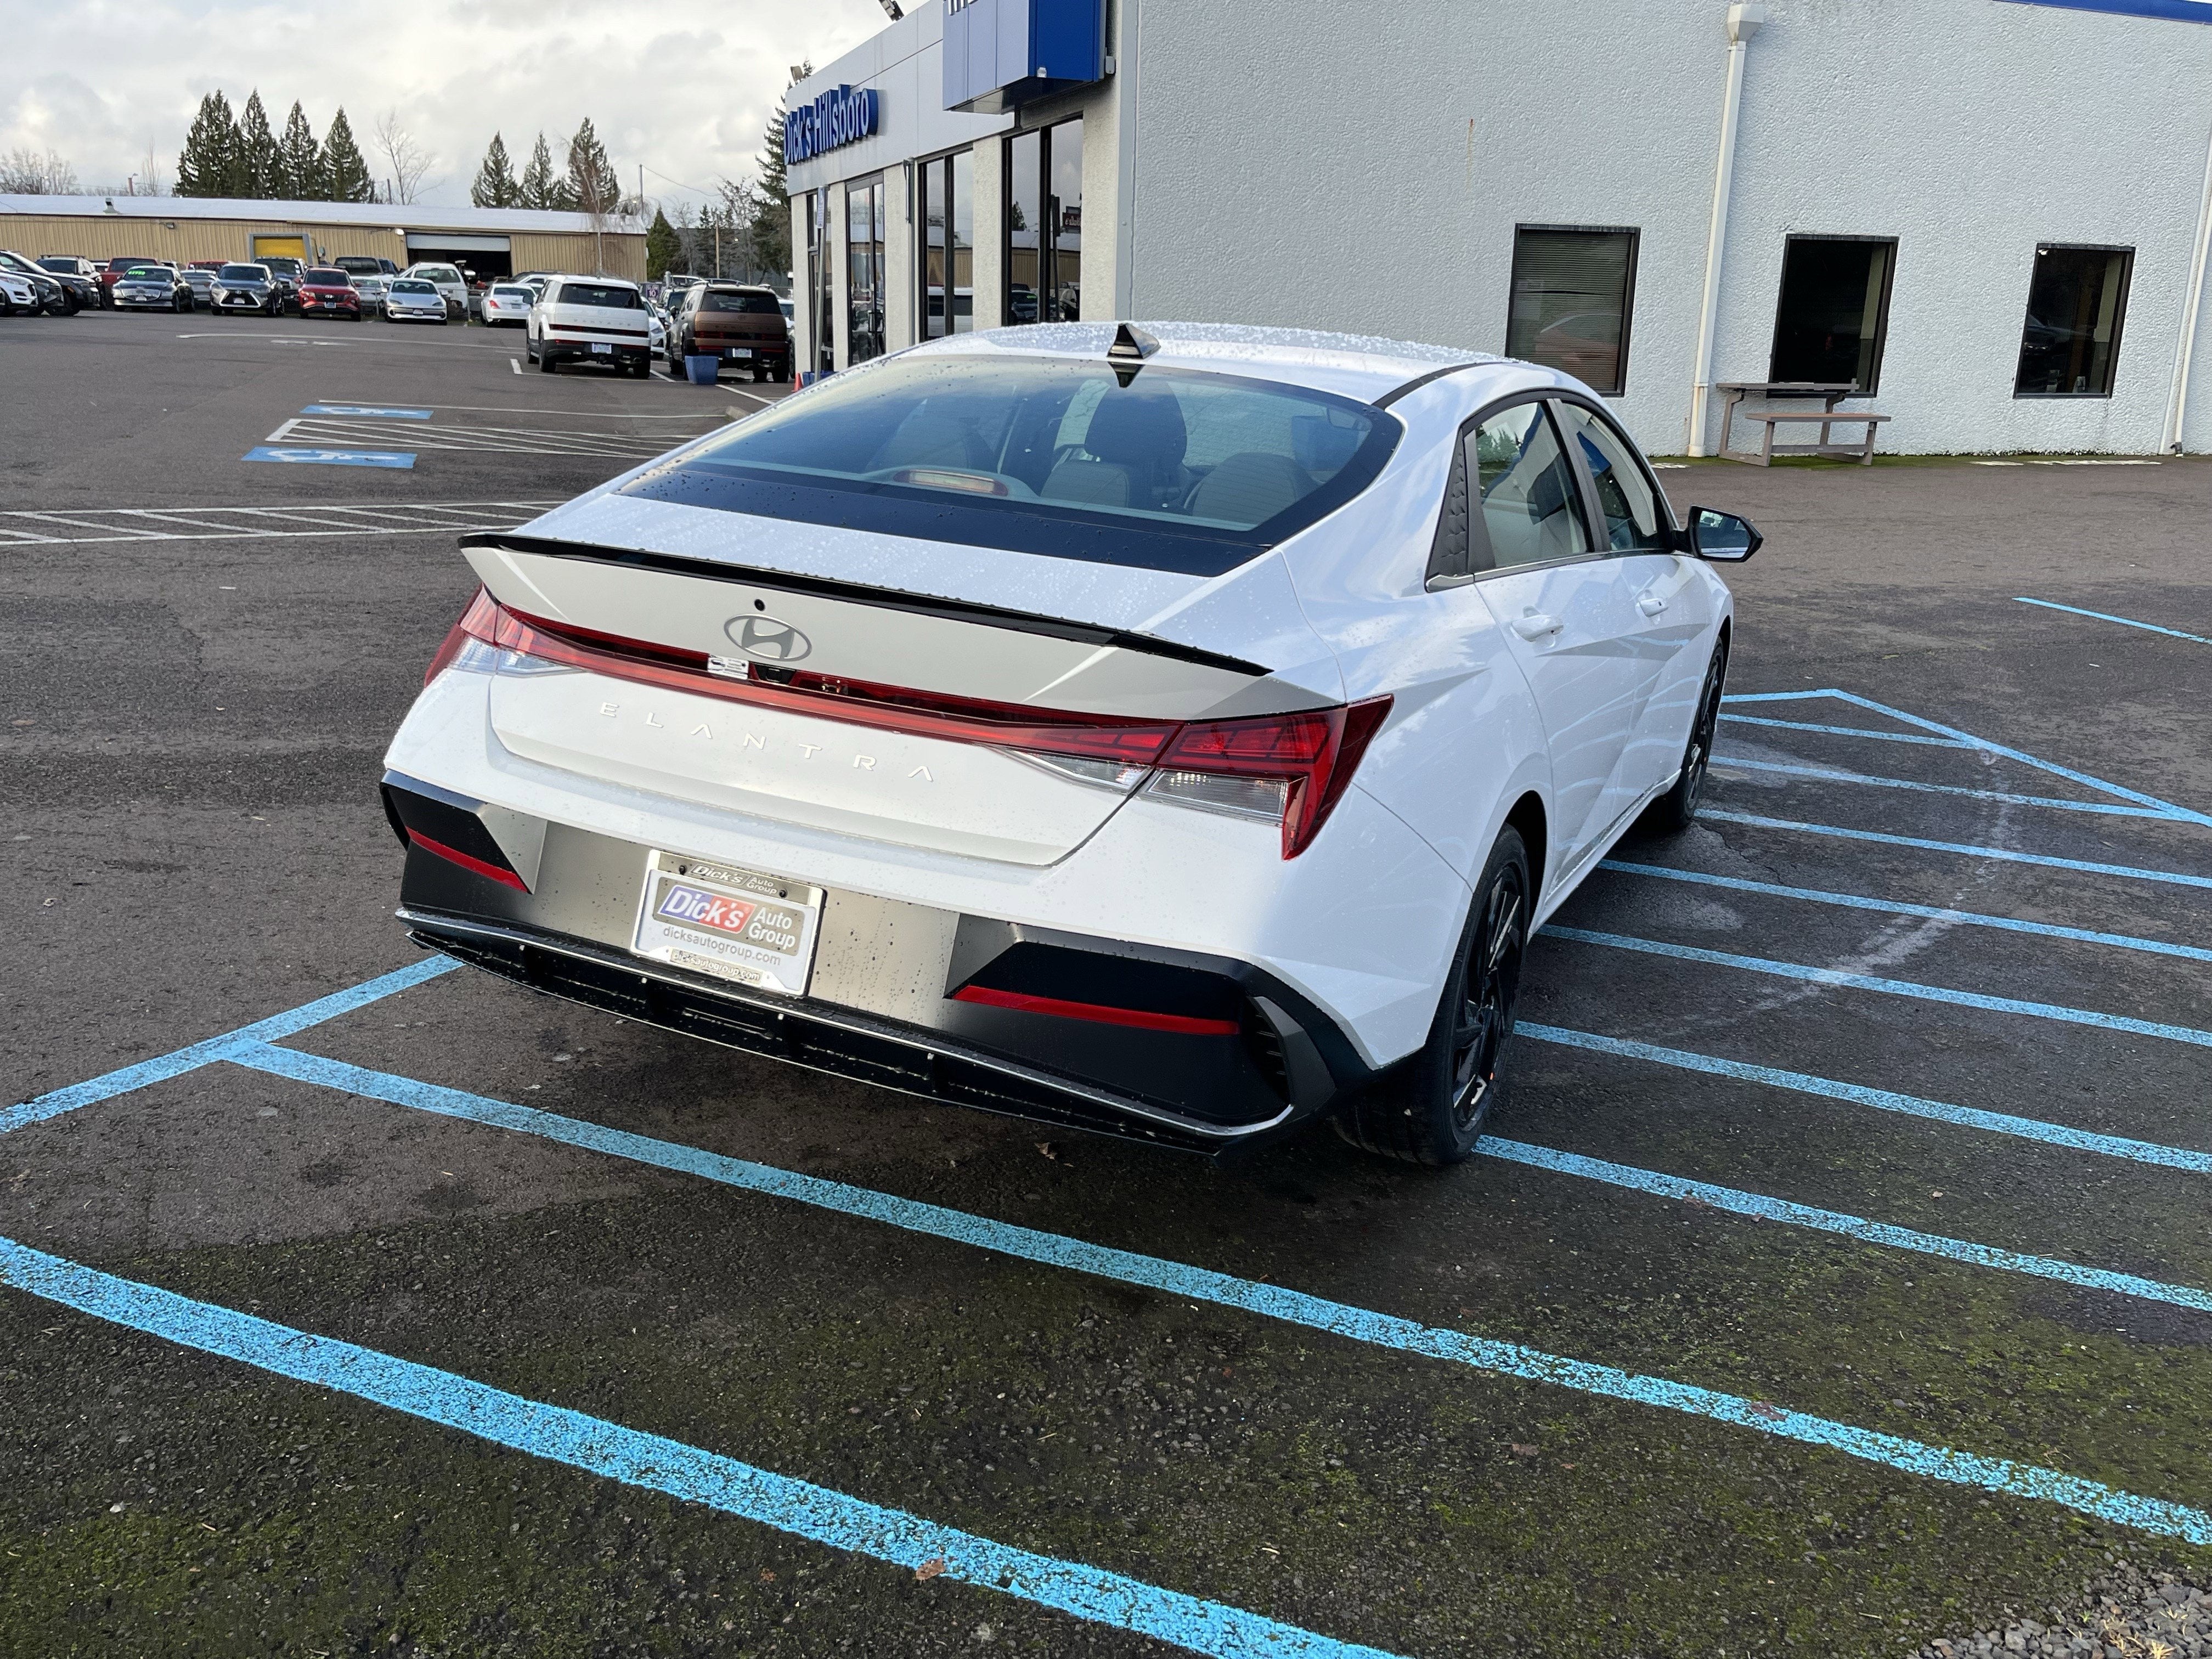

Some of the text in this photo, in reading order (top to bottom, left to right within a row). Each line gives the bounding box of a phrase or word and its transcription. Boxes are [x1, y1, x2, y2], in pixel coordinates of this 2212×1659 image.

[783, 84, 870, 165] Dick's Hillsboro
[600, 701, 933, 782] ELANTRA
[692, 865, 775, 887] Dick's Auto
[746, 882, 778, 895] Group
[665, 890, 793, 929] Dick's Auto
[663, 926, 781, 966] dicksautogroup.com
[748, 923, 795, 950] Group
[673, 950, 761, 981] dicksautogroup.com
